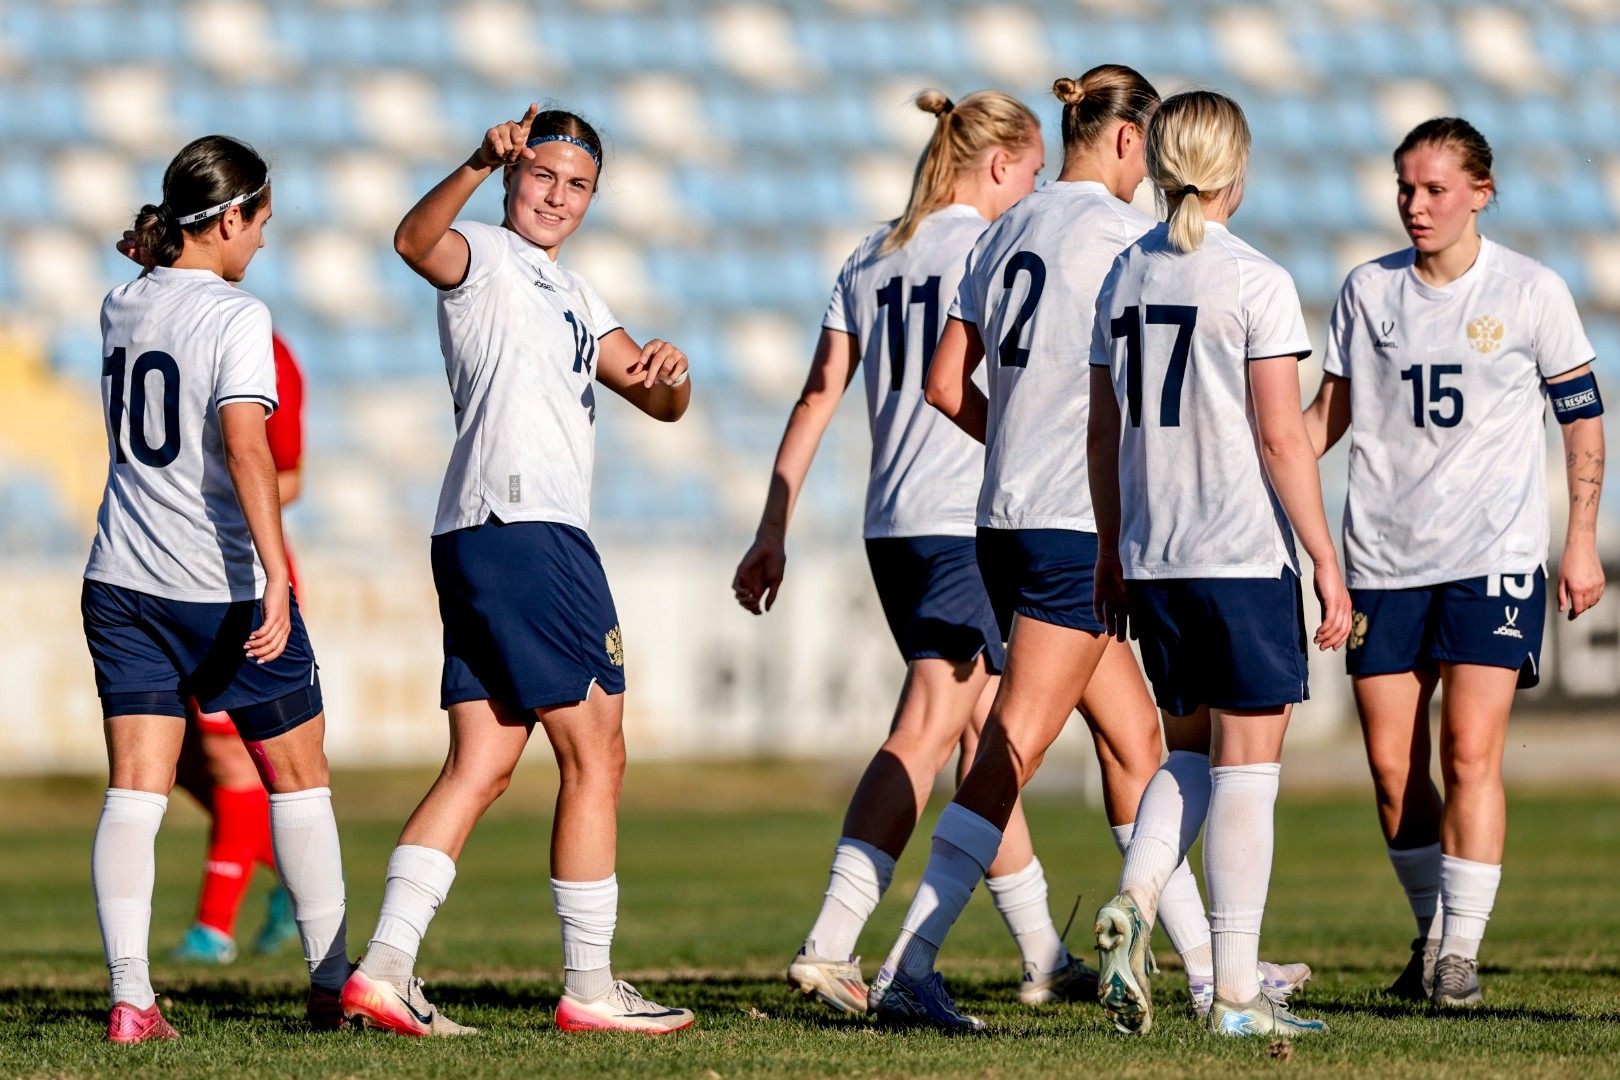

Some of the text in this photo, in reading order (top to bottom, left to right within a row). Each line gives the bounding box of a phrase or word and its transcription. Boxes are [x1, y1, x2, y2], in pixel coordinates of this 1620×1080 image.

[194, 211, 208, 221] NIKE
[875, 275, 942, 392] 11
[998, 250, 1047, 369] 2
[1110, 304, 1198, 428] 17
[101, 346, 181, 469] 10
[1400, 364, 1464, 429] 15
